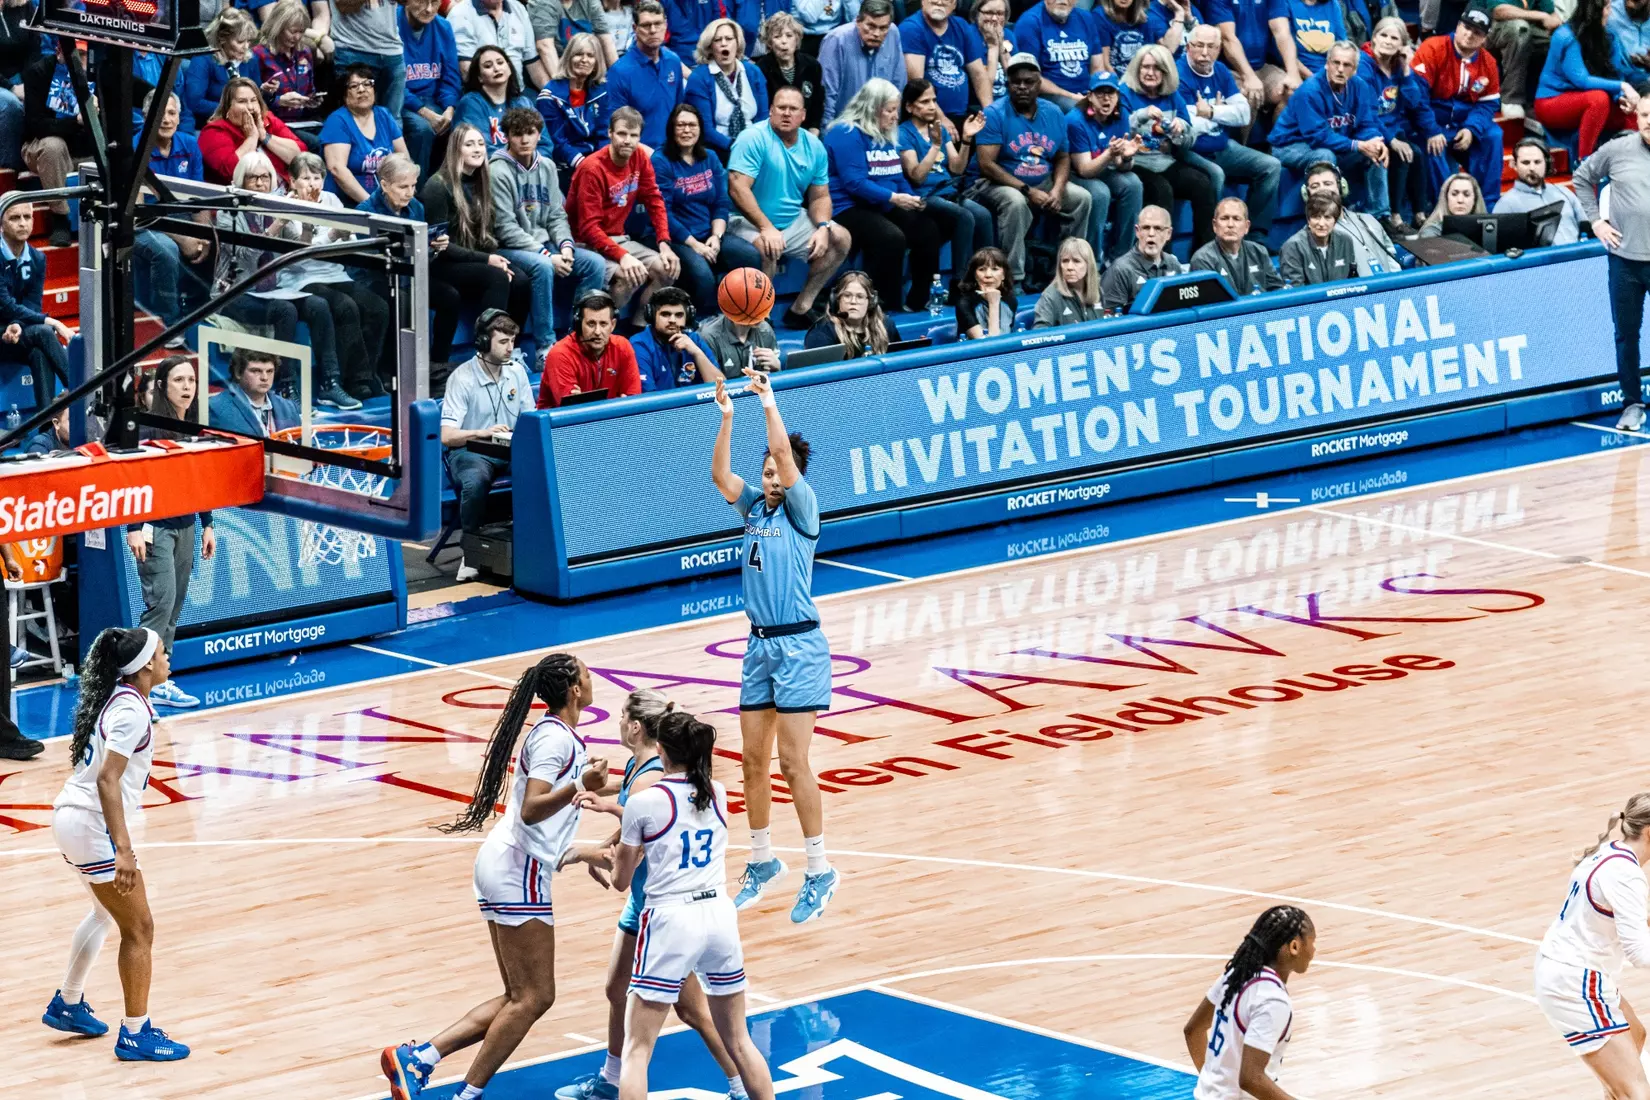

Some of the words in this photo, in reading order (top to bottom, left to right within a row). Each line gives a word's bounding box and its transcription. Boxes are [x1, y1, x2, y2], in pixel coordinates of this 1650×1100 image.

[80, 13, 146, 33] DAKTRONICS
[21, 266, 31, 280] C
[1179, 286, 1199, 300] POSS
[917, 338, 1181, 424] WOMEN'S
[1195, 294, 1456, 379] NATIONAL
[850, 397, 1161, 495] INVITATION
[1173, 334, 1528, 437] TOURNAMENT
[1311, 437, 1358, 457] ROCKET
[1359, 430, 1409, 449] Mortgage
[1007, 490, 1056, 511] ROCKET
[1058, 483, 1110, 502] Mortgage
[681, 547, 733, 570] ROCKET
[748, 540, 763, 572] 4
[204, 632, 262, 655] ROCKET
[264, 625, 326, 645] Mortgage
[932, 654, 1456, 759] Fieldhouse
[678, 828, 713, 870] 13
